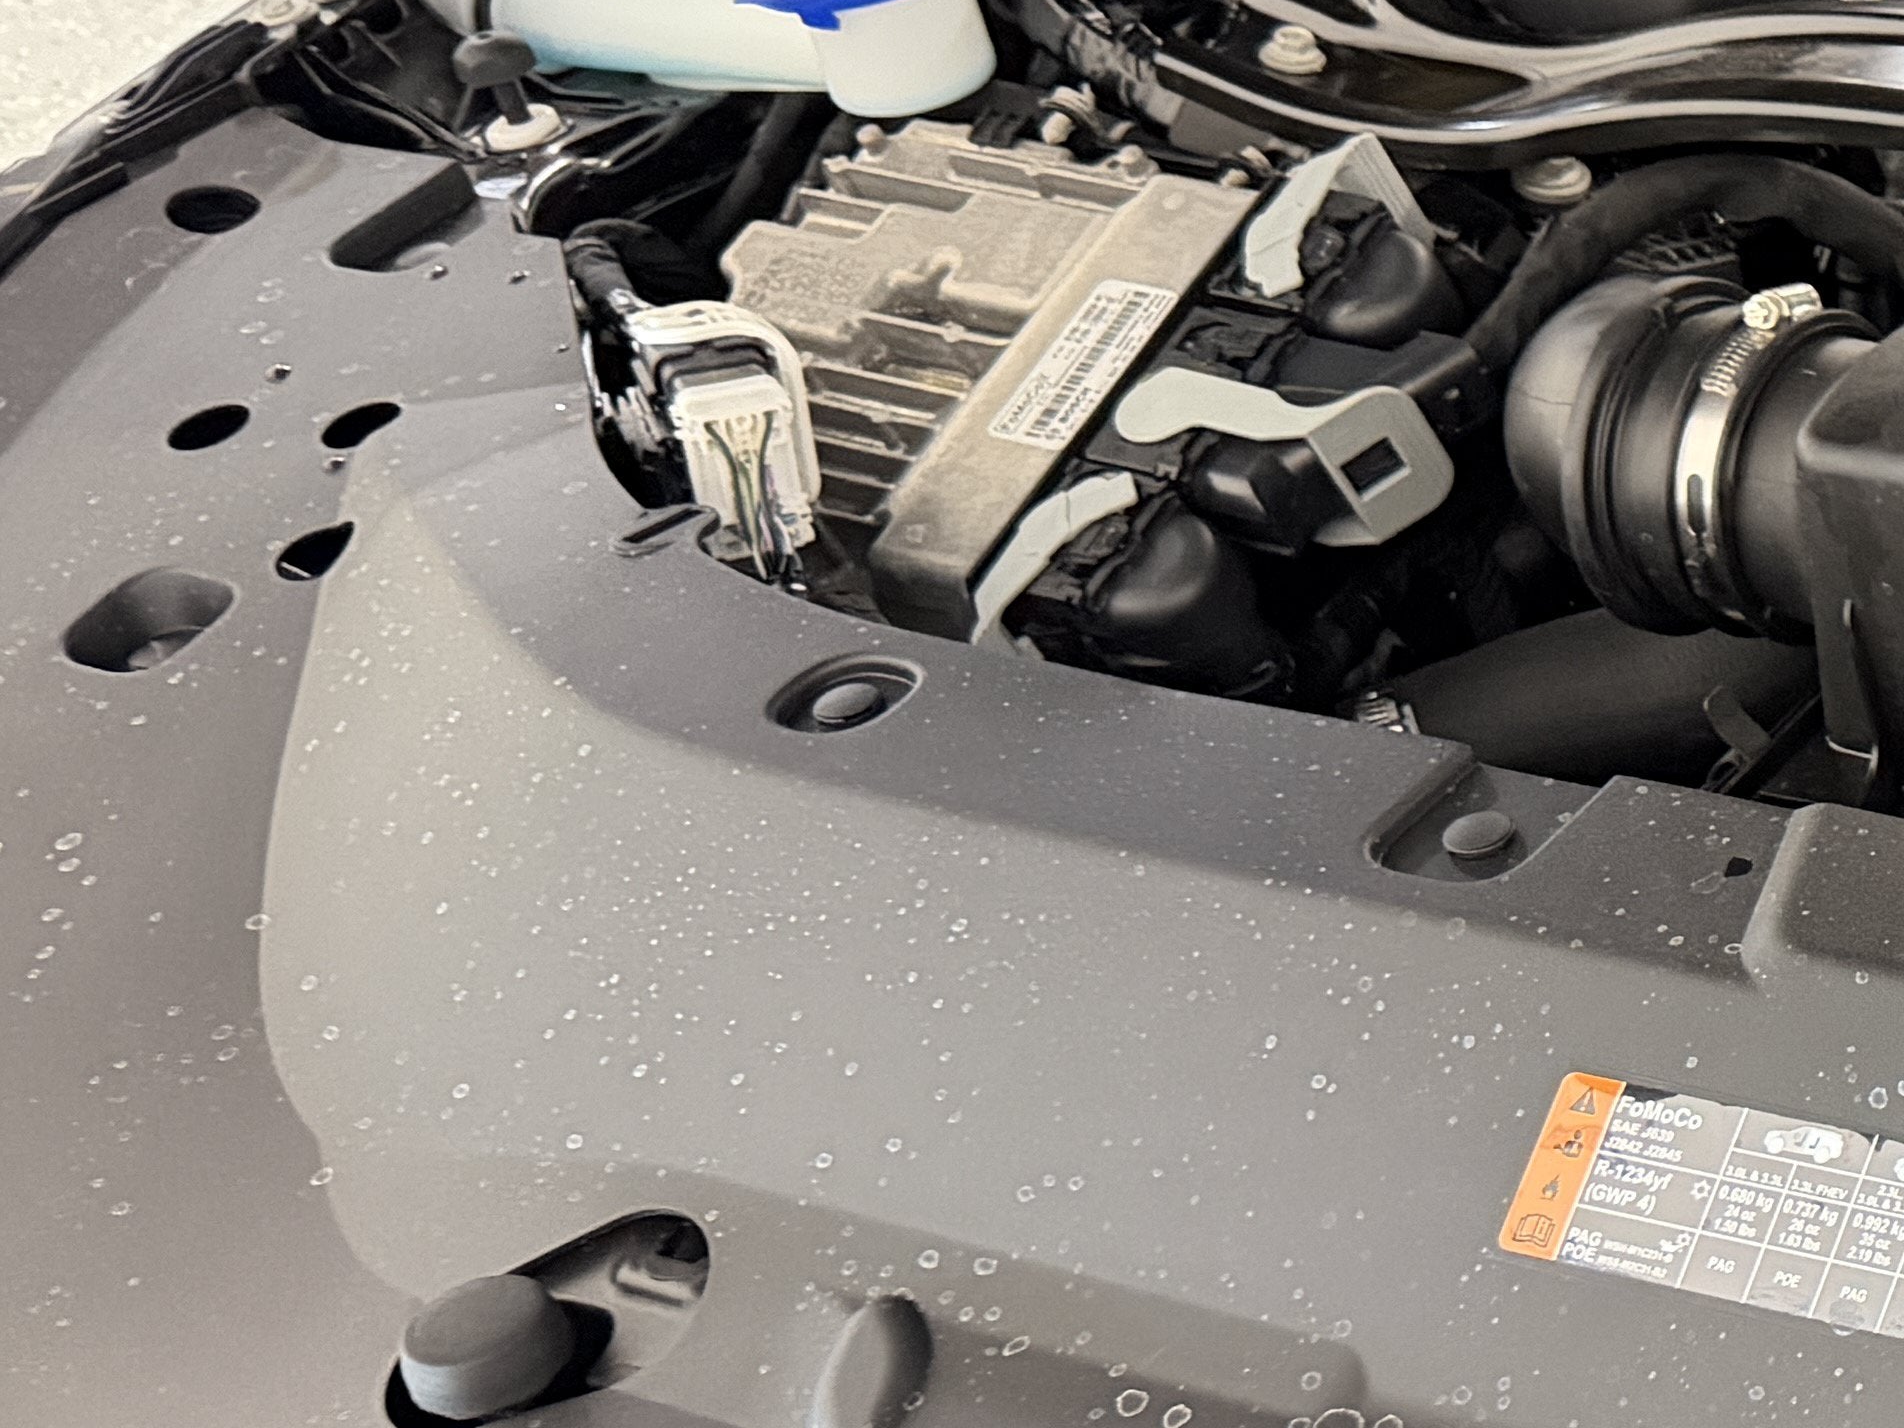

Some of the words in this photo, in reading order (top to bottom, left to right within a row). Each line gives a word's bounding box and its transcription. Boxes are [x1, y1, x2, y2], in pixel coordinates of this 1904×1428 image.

[1615, 1095, 1703, 1130] FoMoCo
[1610, 1119, 1641, 1136] SAE
[1640, 1126, 1675, 1143] J639
[1604, 1136, 1643, 1155] J2842
[1643, 1146, 1683, 1162] J2845
[1594, 1159, 1673, 1192] R-1234yf
[1583, 1183, 1637, 1207] (GWP
[1636, 1195, 1657, 1216] 4)
[1718, 1185, 1756, 1205] 0.680
[1755, 1193, 1775, 1213] kg
[1815, 1184, 1848, 1200] FHEV
[1724, 1204, 1740, 1217] 24
[1740, 1210, 1757, 1222] oz
[1783, 1198, 1820, 1218] 0.737
[1819, 1206, 1839, 1227] kg
[1713, 1217, 1737, 1234] 1.50
[1737, 1223, 1757, 1238] lbs
[1787, 1218, 1804, 1232] 26
[1804, 1224, 1821, 1236] oz
[1852, 1213, 1891, 1234] 0.992
[1568, 1227, 1602, 1247] PAG
[1778, 1232, 1802, 1248] 1.63
[1802, 1237, 1821, 1252] lbs
[1859, 1233, 1875, 1247] 35
[1875, 1238, 1891, 1250] oz
[1561, 1243, 1599, 1262] POE
[1846, 1246, 1872, 1263] 2.19
[1872, 1252, 1891, 1267] lbs
[1705, 1255, 1736, 1274] PAG
[1773, 1270, 1802, 1288] POE
[1839, 1285, 1868, 1303] PAG
